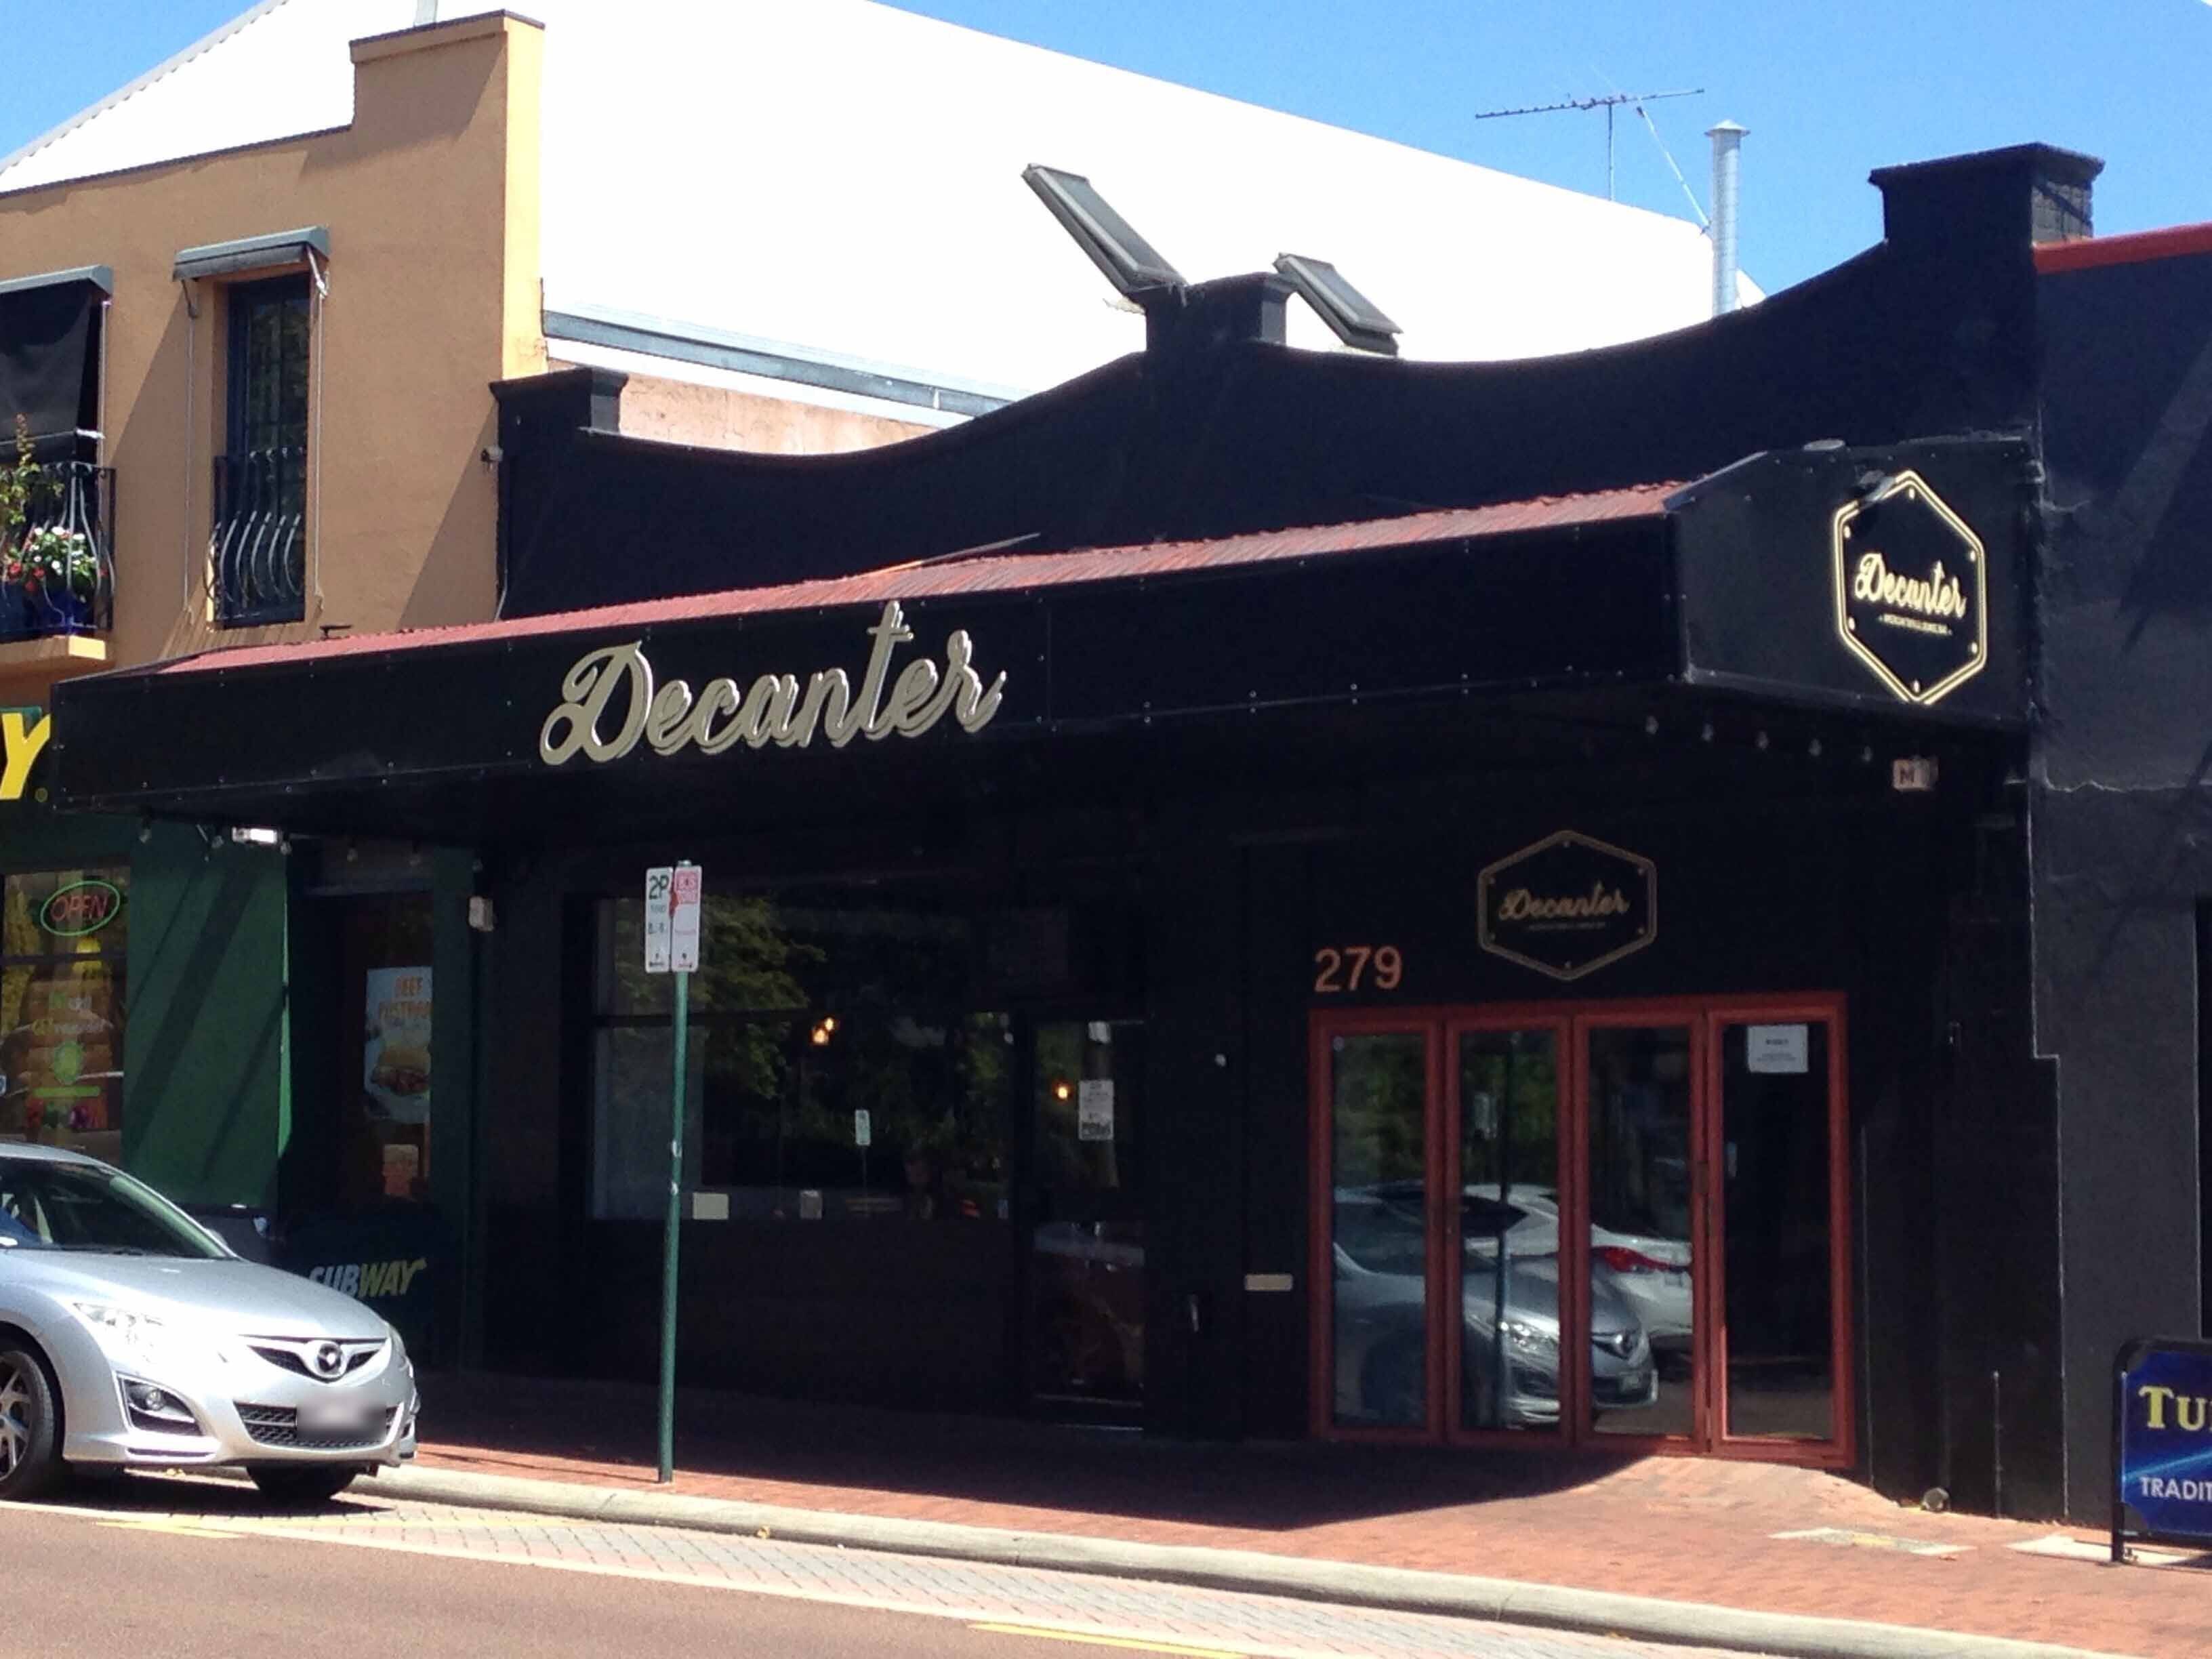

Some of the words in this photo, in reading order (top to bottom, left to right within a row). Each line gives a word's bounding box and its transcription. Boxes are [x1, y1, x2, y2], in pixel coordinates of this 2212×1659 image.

[1854, 552, 1967, 619] Decanter
[540, 600, 1006, 765] Decanter
[49, 893, 108, 922] OPEN
[649, 874, 670, 900] 2P
[1498, 882, 1631, 920] Decanter
[1315, 946, 1402, 993] 279
[2138, 1385, 2212, 1432] TU
